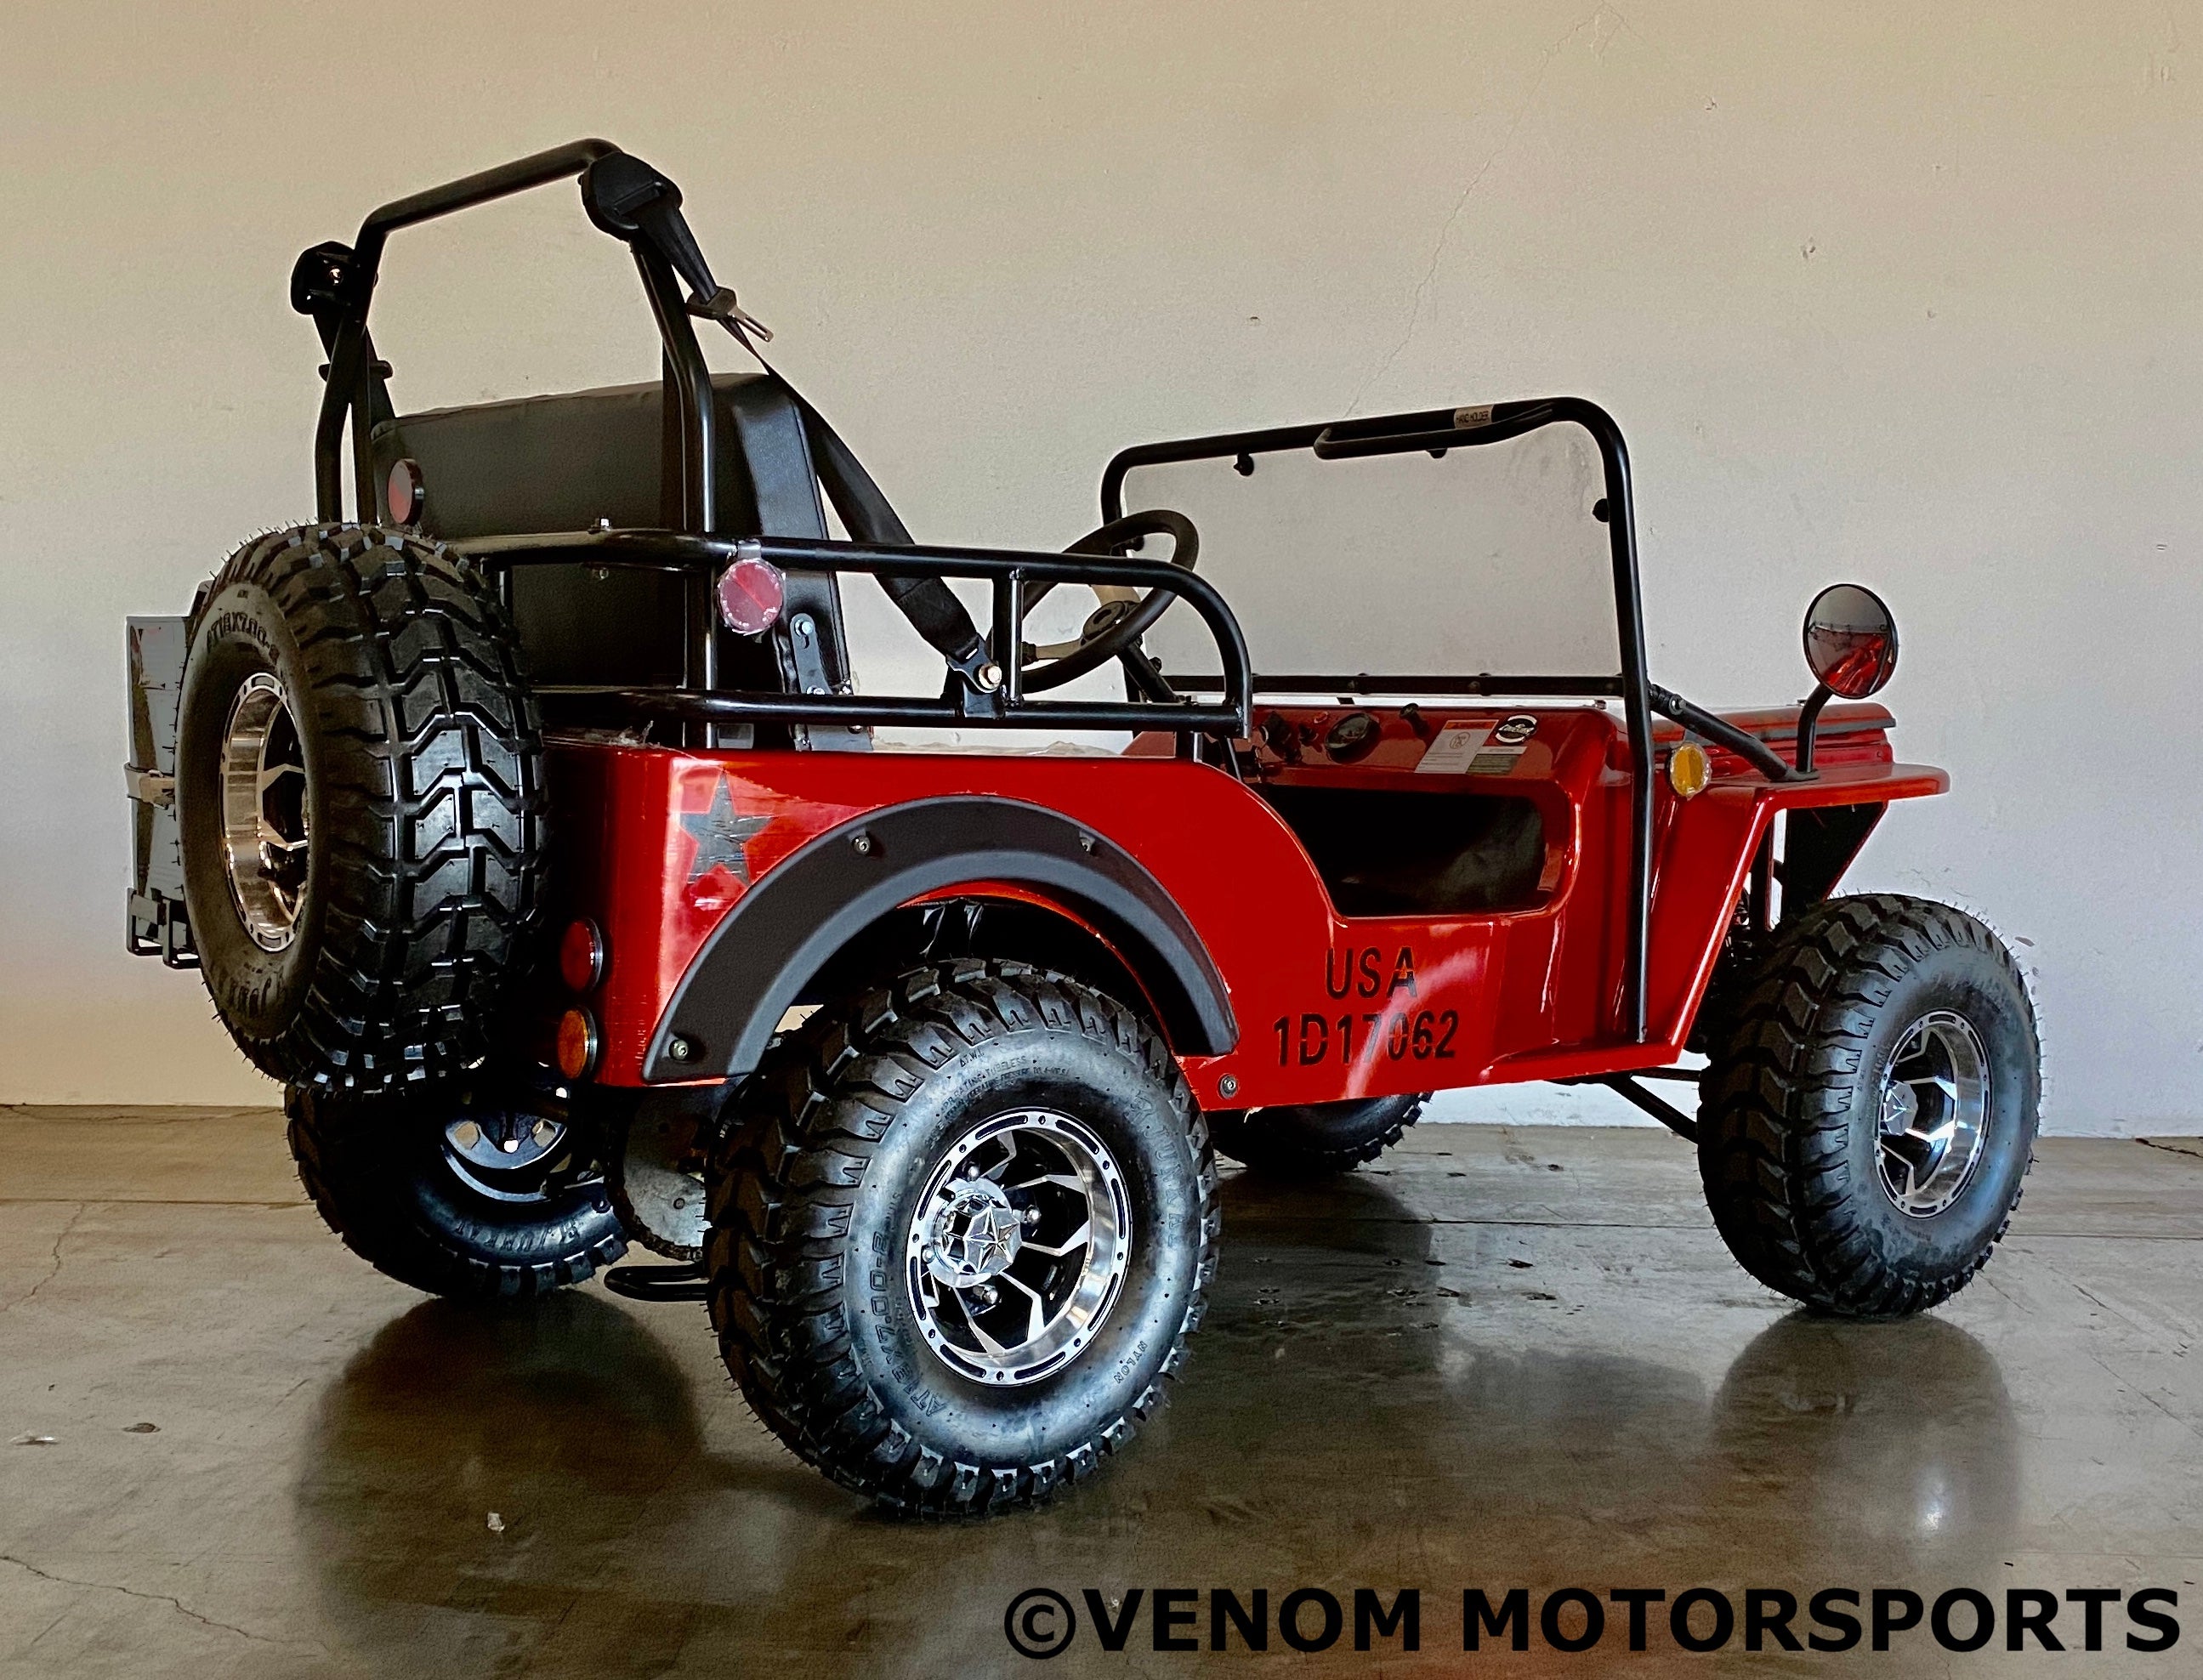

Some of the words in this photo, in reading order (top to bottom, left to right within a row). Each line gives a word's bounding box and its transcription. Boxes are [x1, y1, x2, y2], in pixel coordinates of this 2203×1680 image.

[1326, 945, 1418, 1000] USA
[1273, 1009, 1460, 1067] 1D17062
[1113, 1340, 1148, 1384] NYLON
